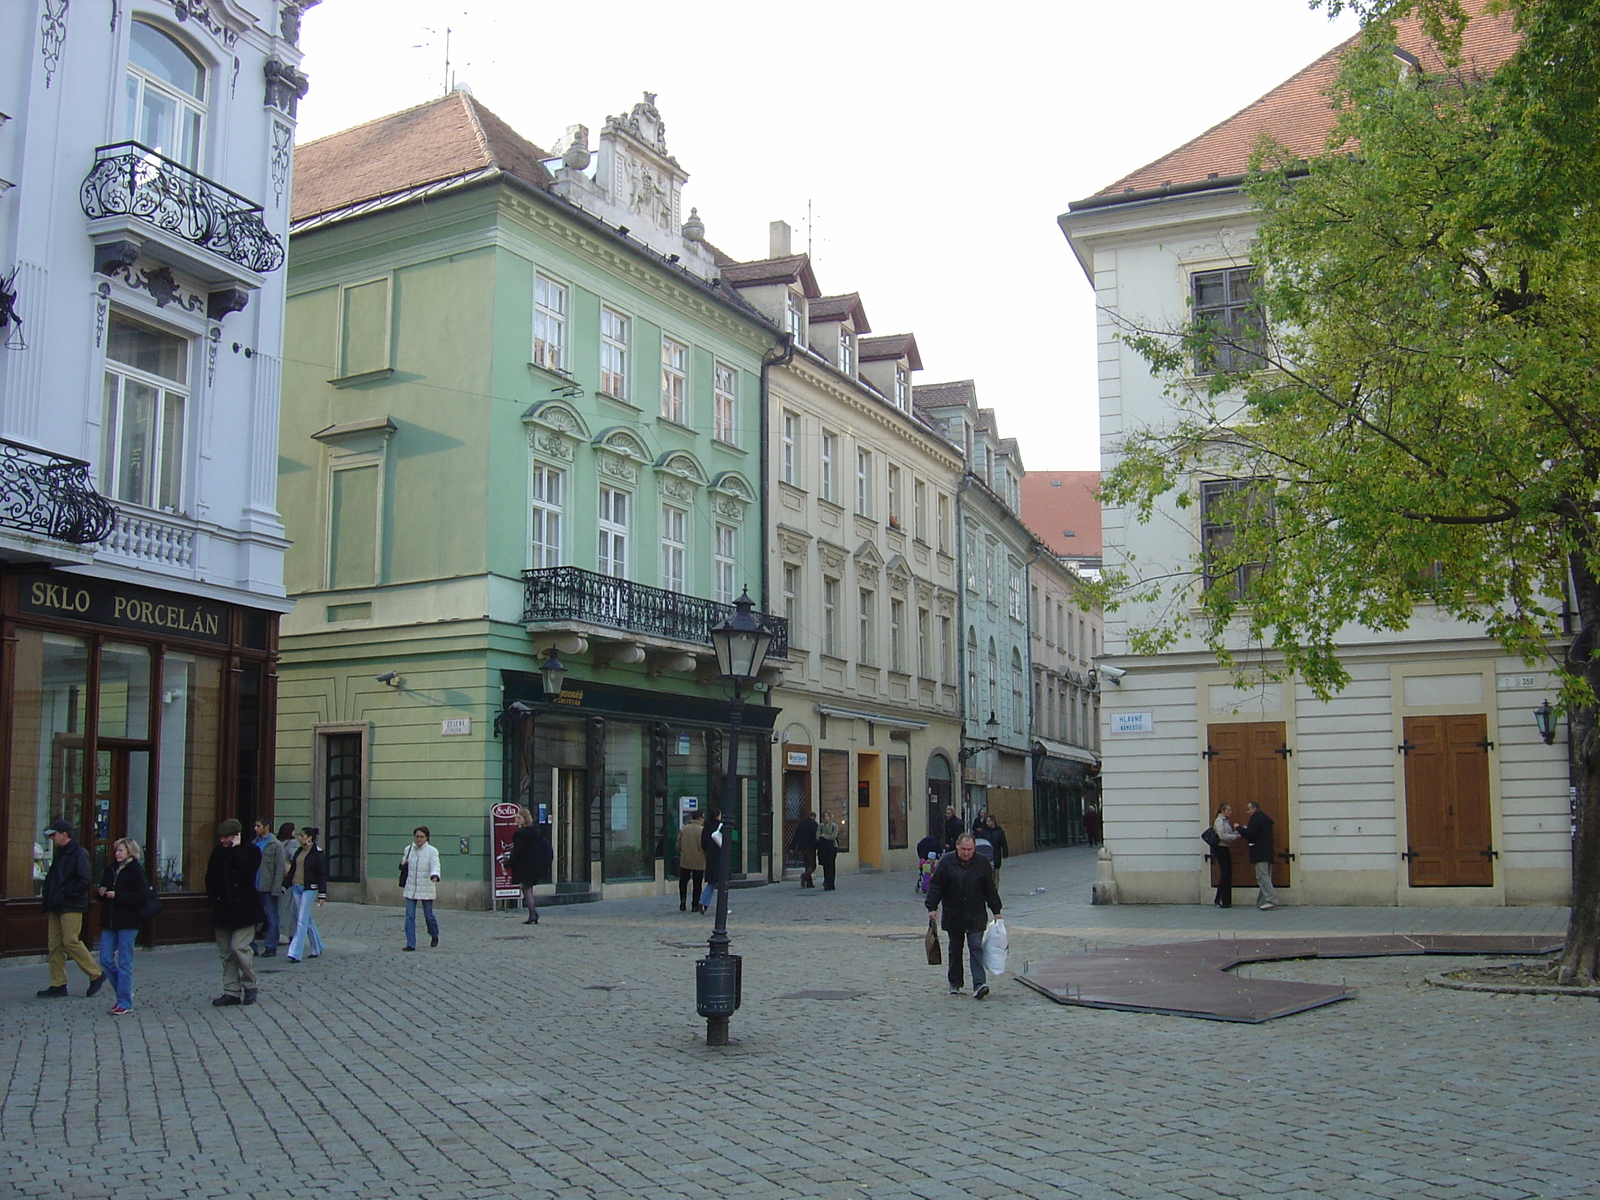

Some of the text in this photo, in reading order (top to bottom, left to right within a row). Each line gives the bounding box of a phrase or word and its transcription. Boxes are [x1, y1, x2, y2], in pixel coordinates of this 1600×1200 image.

[31, 582, 218, 635] SKLO PORCELÁN
[1118, 715, 1143, 723] HLAVNÉ
